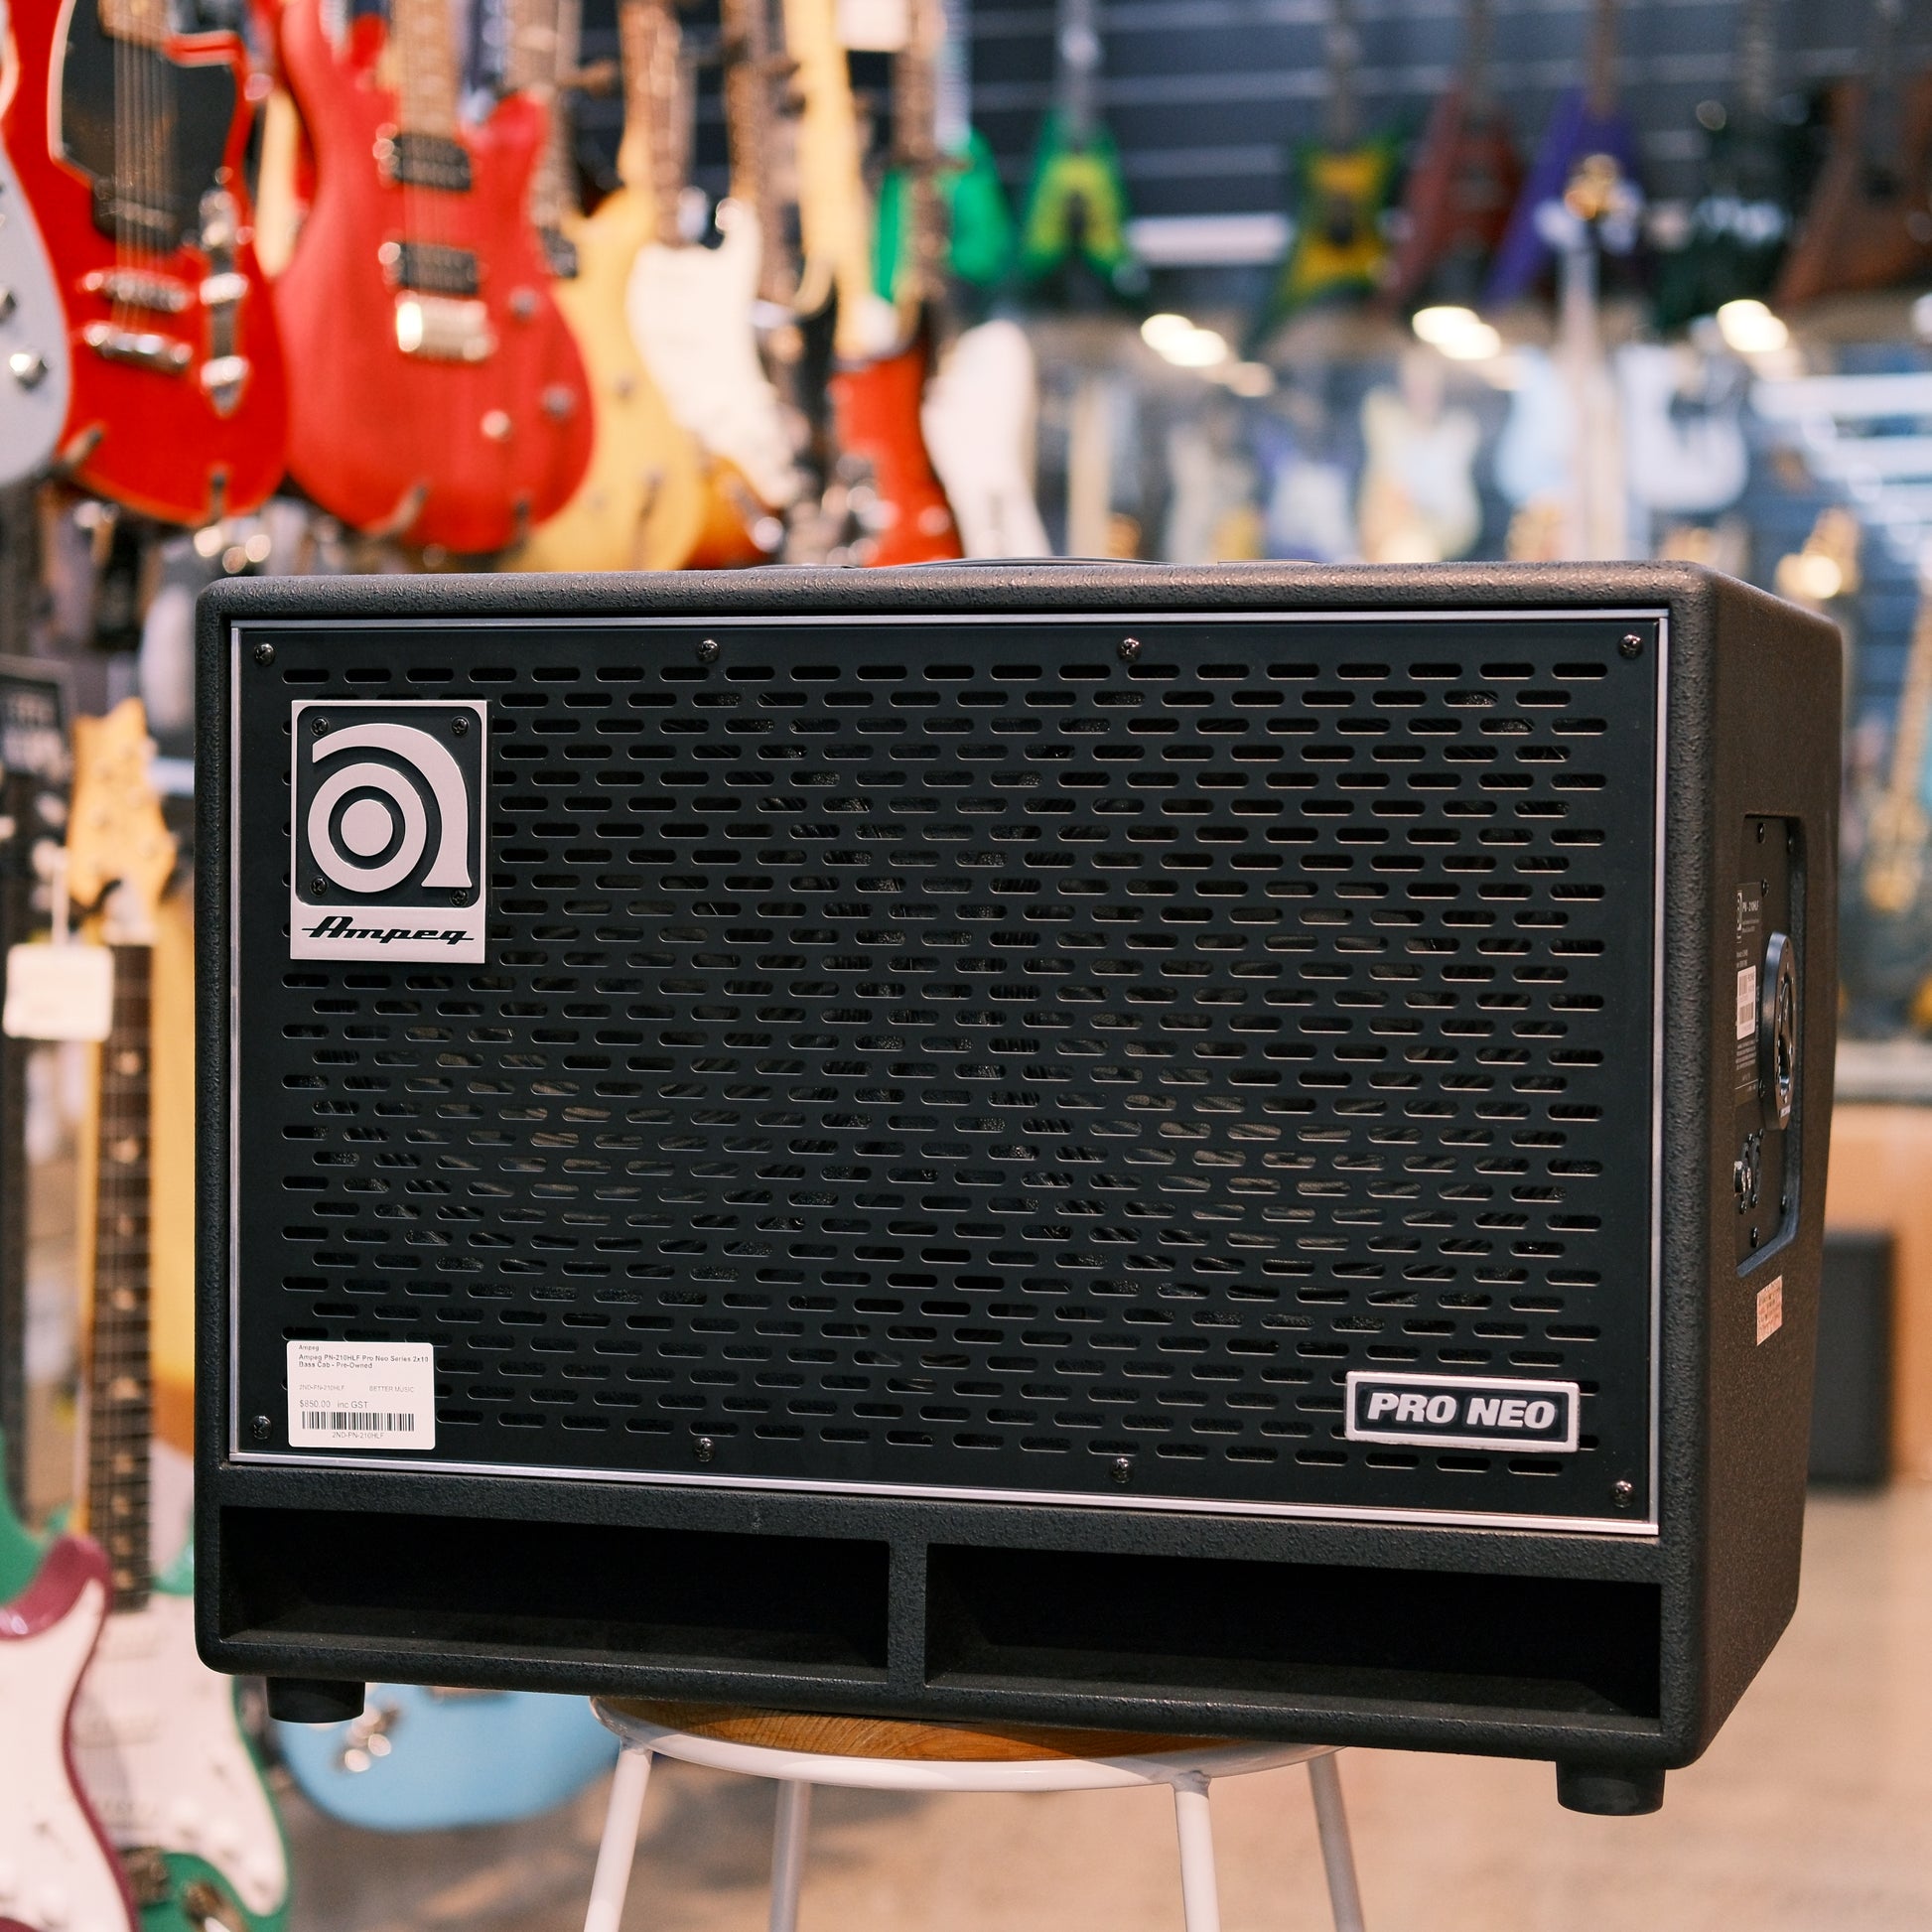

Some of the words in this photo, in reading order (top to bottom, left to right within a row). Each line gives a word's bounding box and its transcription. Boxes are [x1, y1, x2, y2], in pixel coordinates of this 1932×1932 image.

[302, 915, 475, 945] Ampeg
[299, 1399, 331, 1408] $850.00
[1367, 1392, 1456, 1424] PRO
[1466, 1398, 1556, 1429] NEO
